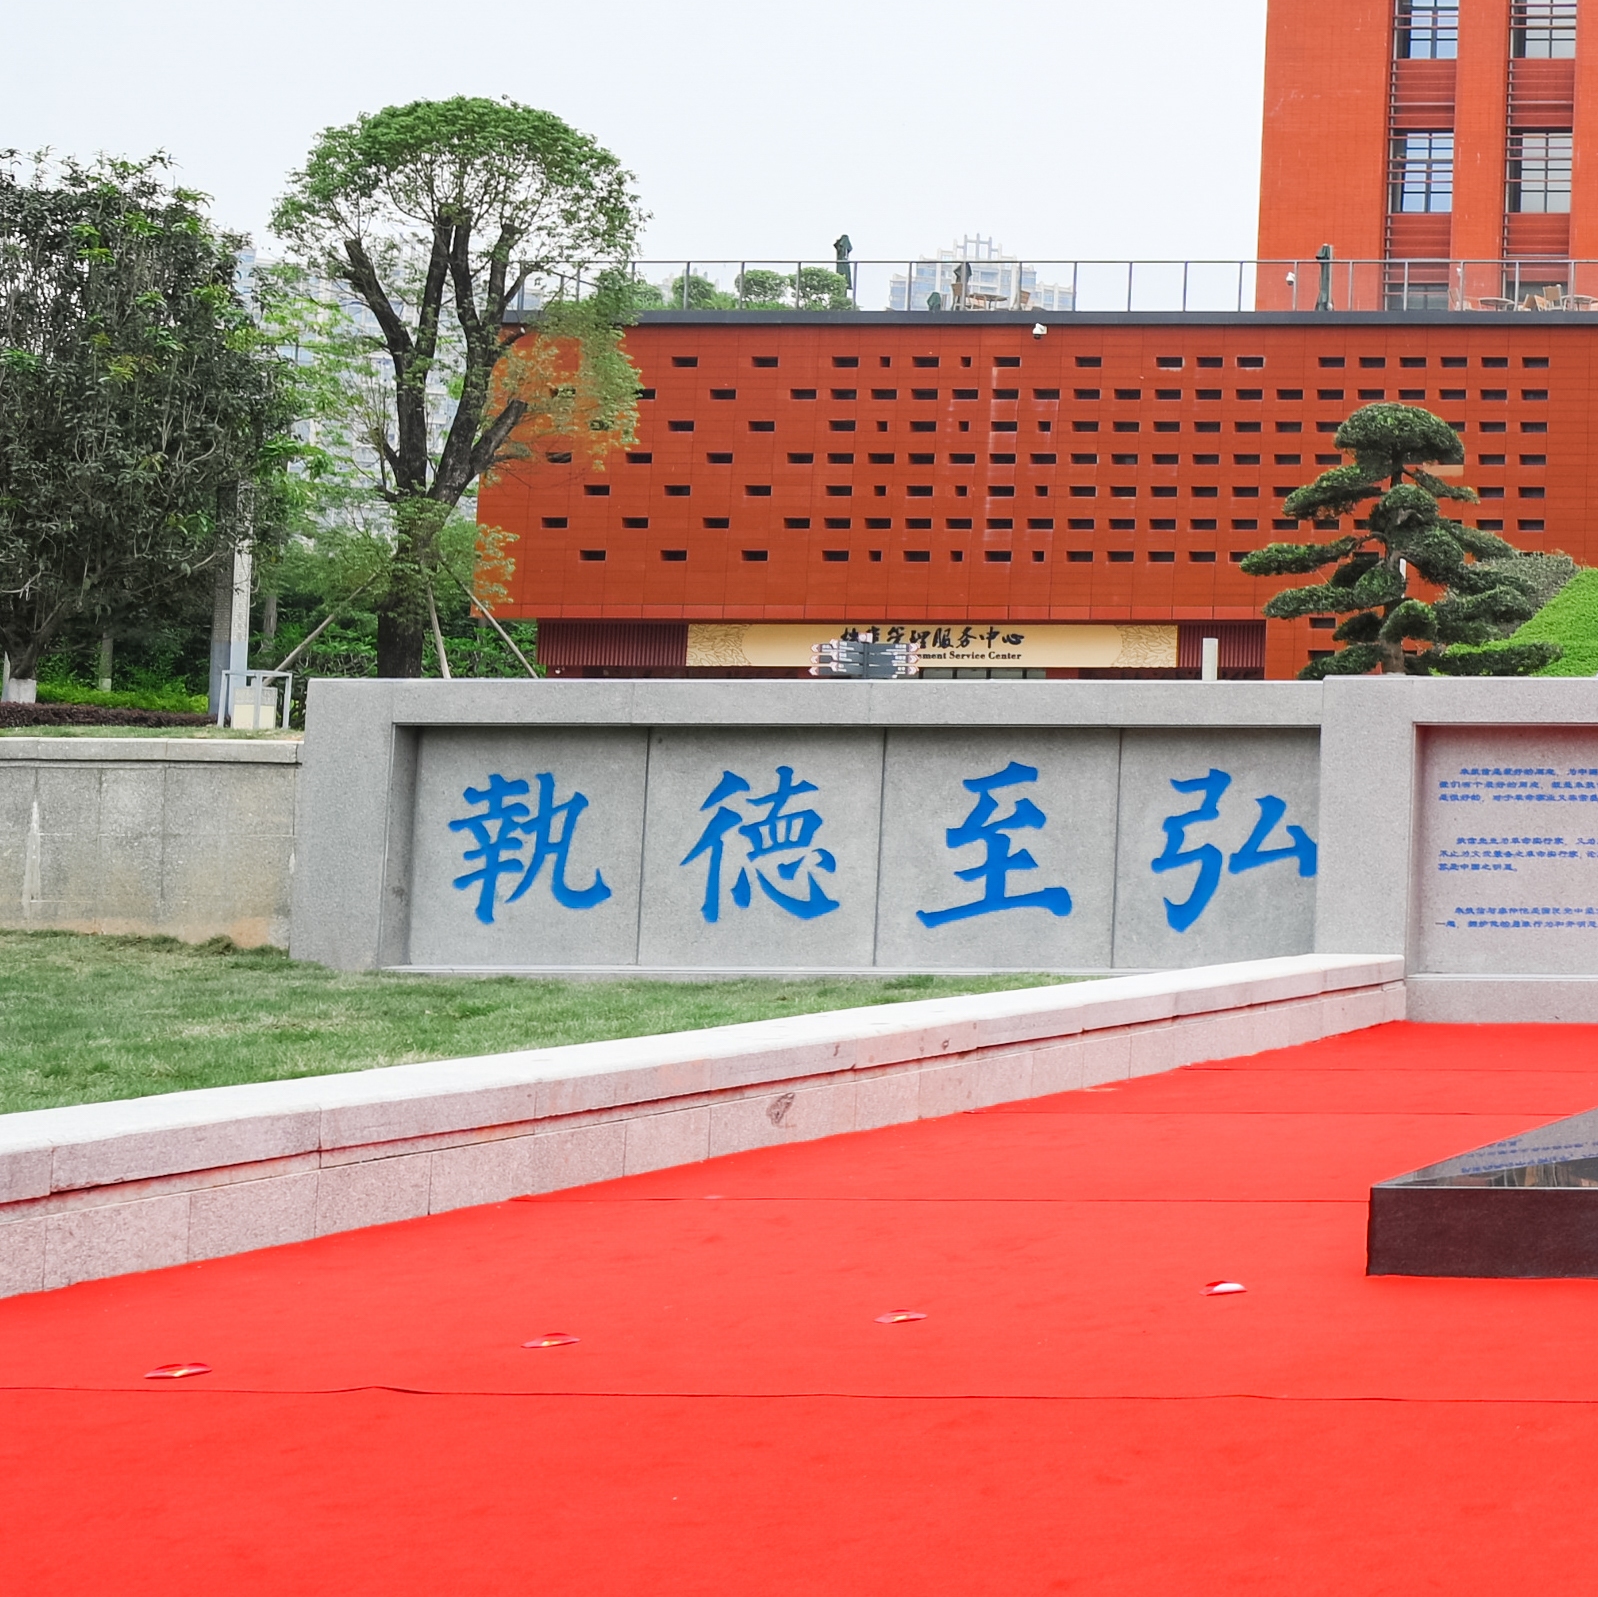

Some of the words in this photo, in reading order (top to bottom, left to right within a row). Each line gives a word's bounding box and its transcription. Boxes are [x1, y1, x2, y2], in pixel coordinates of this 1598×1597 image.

[949, 651, 986, 660] Service
[988, 651, 1022, 660] Center
[446, 759, 1319, 935] 執德至弘
